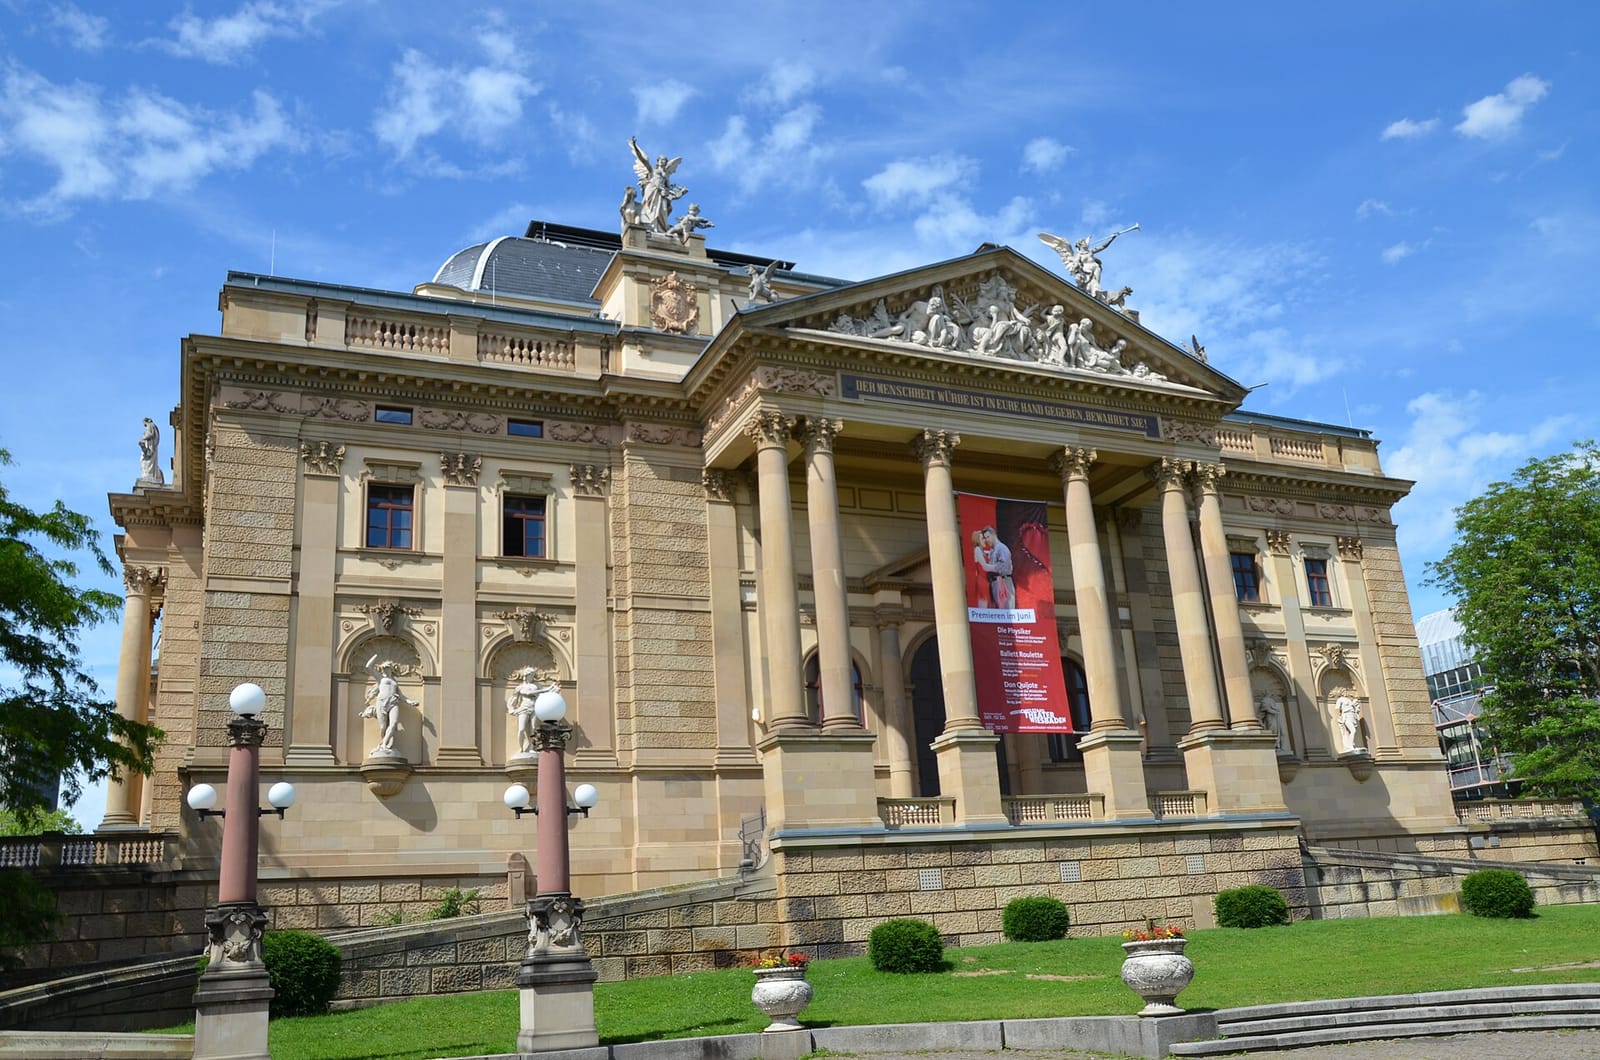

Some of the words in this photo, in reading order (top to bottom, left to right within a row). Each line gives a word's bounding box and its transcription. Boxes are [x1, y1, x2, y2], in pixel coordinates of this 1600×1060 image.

[856, 380, 876, 393] DER
[877, 383, 936, 400] MENSCHHEIT
[938, 389, 969, 405] WÜRDE
[971, 396, 984, 407] IST
[987, 398, 996, 409] IN
[997, 399, 1020, 412] EURE
[1021, 402, 1044, 415] HAND
[1086, 412, 1129, 426] BEWAHRET
[1131, 417, 1148, 429] SIE!
[971, 610, 1005, 620] Premieren
[1007, 611, 1016, 620] im
[1017, 611, 1032, 621] Juni
[1008, 627, 1031, 636] Physiker
[1025, 710, 1054, 719] THEATER
